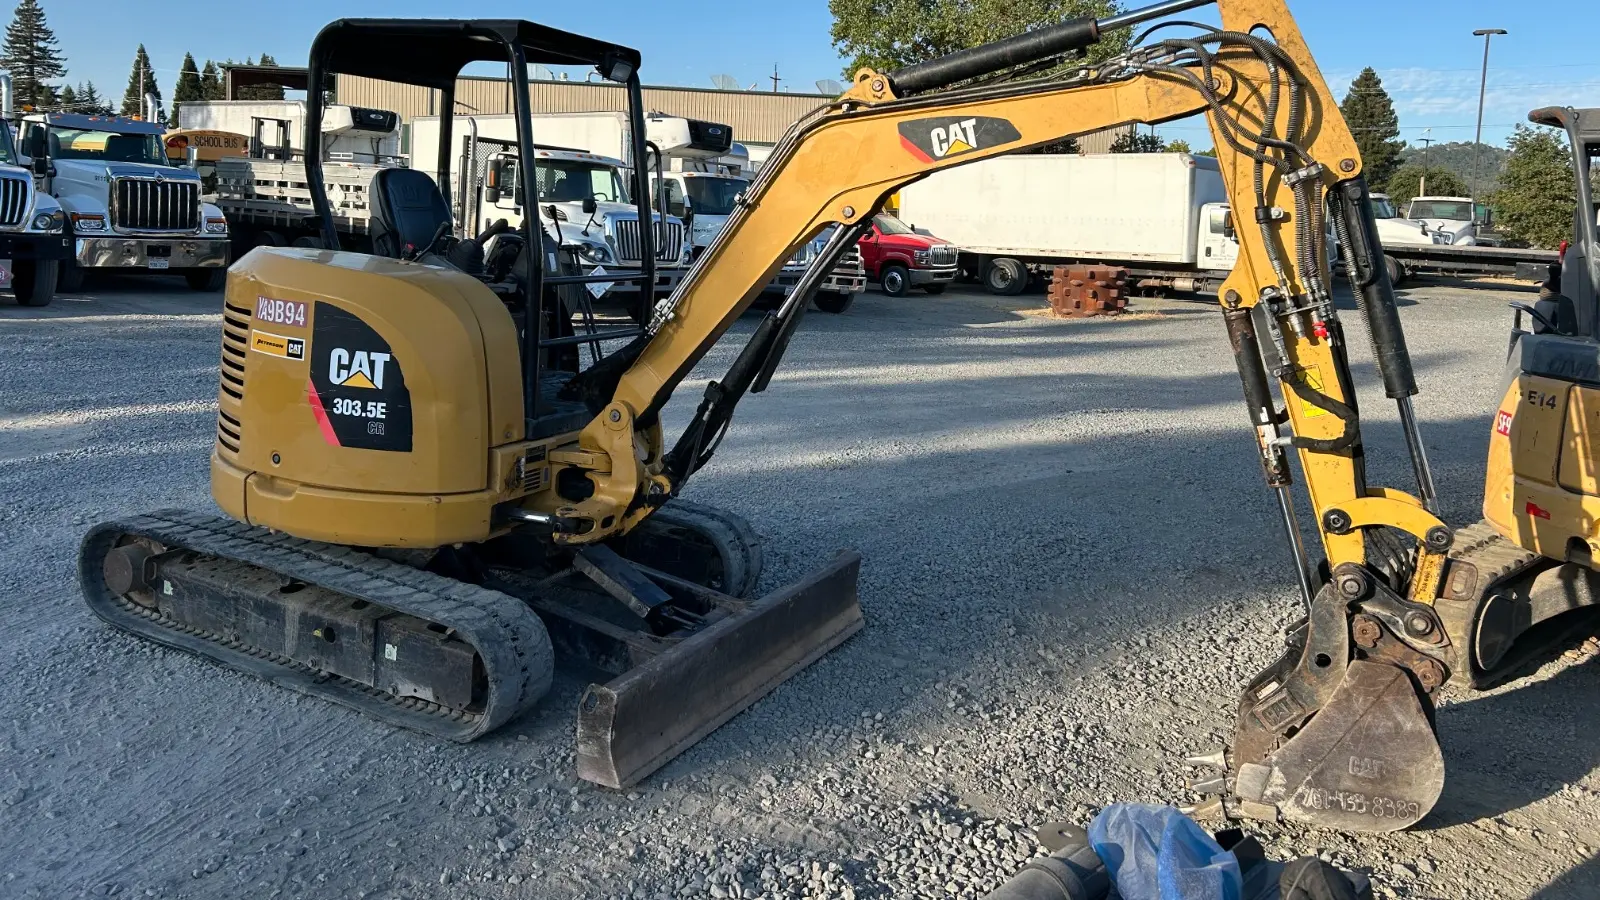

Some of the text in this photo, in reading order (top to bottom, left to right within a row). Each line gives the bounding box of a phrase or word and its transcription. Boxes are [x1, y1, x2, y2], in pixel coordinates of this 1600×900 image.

[195, 136, 238, 149] SCHOOL BUS
[930, 118, 978, 157] CAT
[257, 296, 305, 326] YA9B94
[288, 343, 302, 355] CAT
[329, 347, 391, 390] CAT
[332, 397, 387, 419] 303.5E
[367, 421, 385, 436] CR
[1348, 755, 1385, 779] CAT
